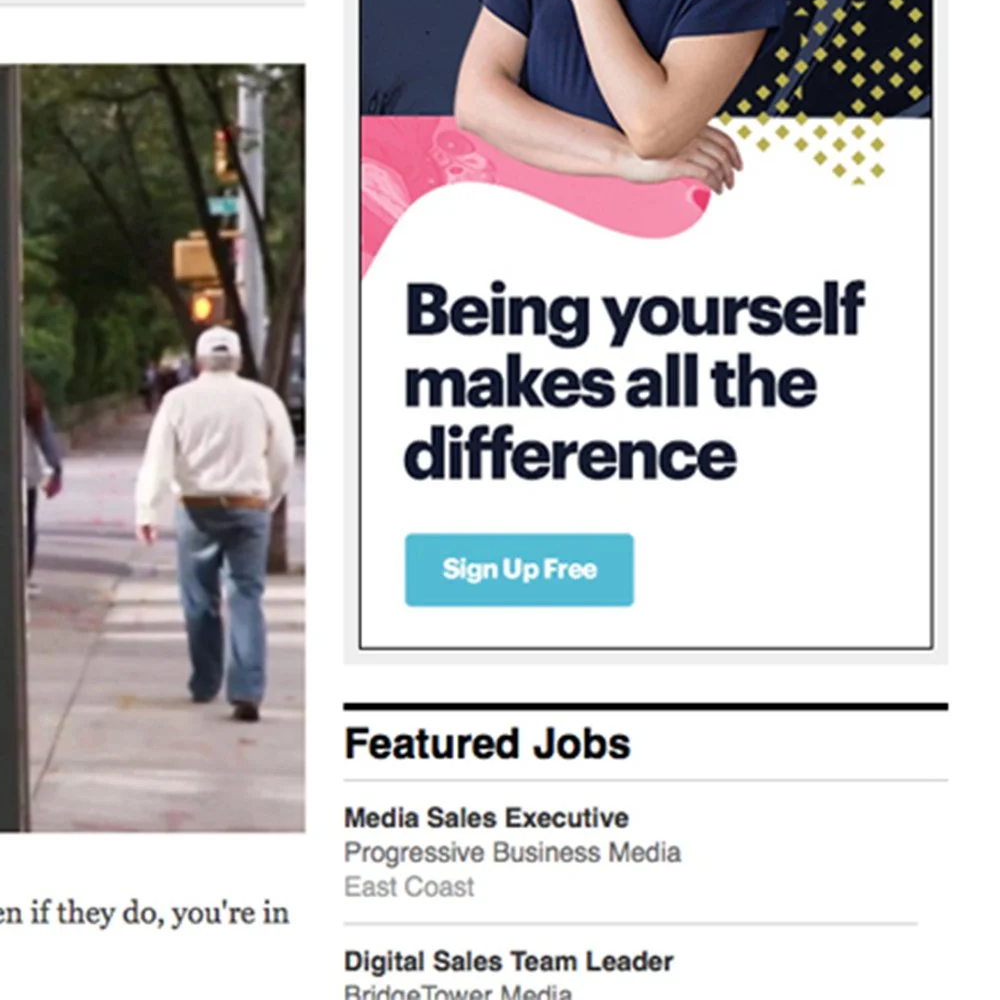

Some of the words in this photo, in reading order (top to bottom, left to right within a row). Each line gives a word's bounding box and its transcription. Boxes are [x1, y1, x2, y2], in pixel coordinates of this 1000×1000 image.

[407, 280, 590, 348] Being
[601, 279, 866, 348] yourself
[405, 353, 615, 408] makes
[625, 353, 698, 408] all
[710, 352, 817, 408] the
[404, 424, 737, 481] difference
[443, 557, 498, 584] Sign
[503, 558, 540, 583] Up
[544, 558, 598, 580] Free
[345, 727, 519, 759] Featured
[533, 727, 631, 760] Jobs
[345, 807, 419, 828] Media
[427, 806, 497, 828] Sales
[506, 807, 629, 828] Executive
[345, 841, 485, 869] Progressive
[493, 841, 601, 863] Business
[609, 841, 682, 863] Media
[345, 875, 397, 897] East
[404, 875, 474, 897] Coast
[31, 898, 52, 924] if
[56, 898, 116, 930] they
[122, 898, 164, 929] do,
[171, 899, 255, 930] you're
[263, 899, 289, 924] in
[345, 950, 424, 977] Digital
[433, 949, 503, 972] Sales
[510, 950, 577, 972] Team
[586, 950, 674, 972] Leader
